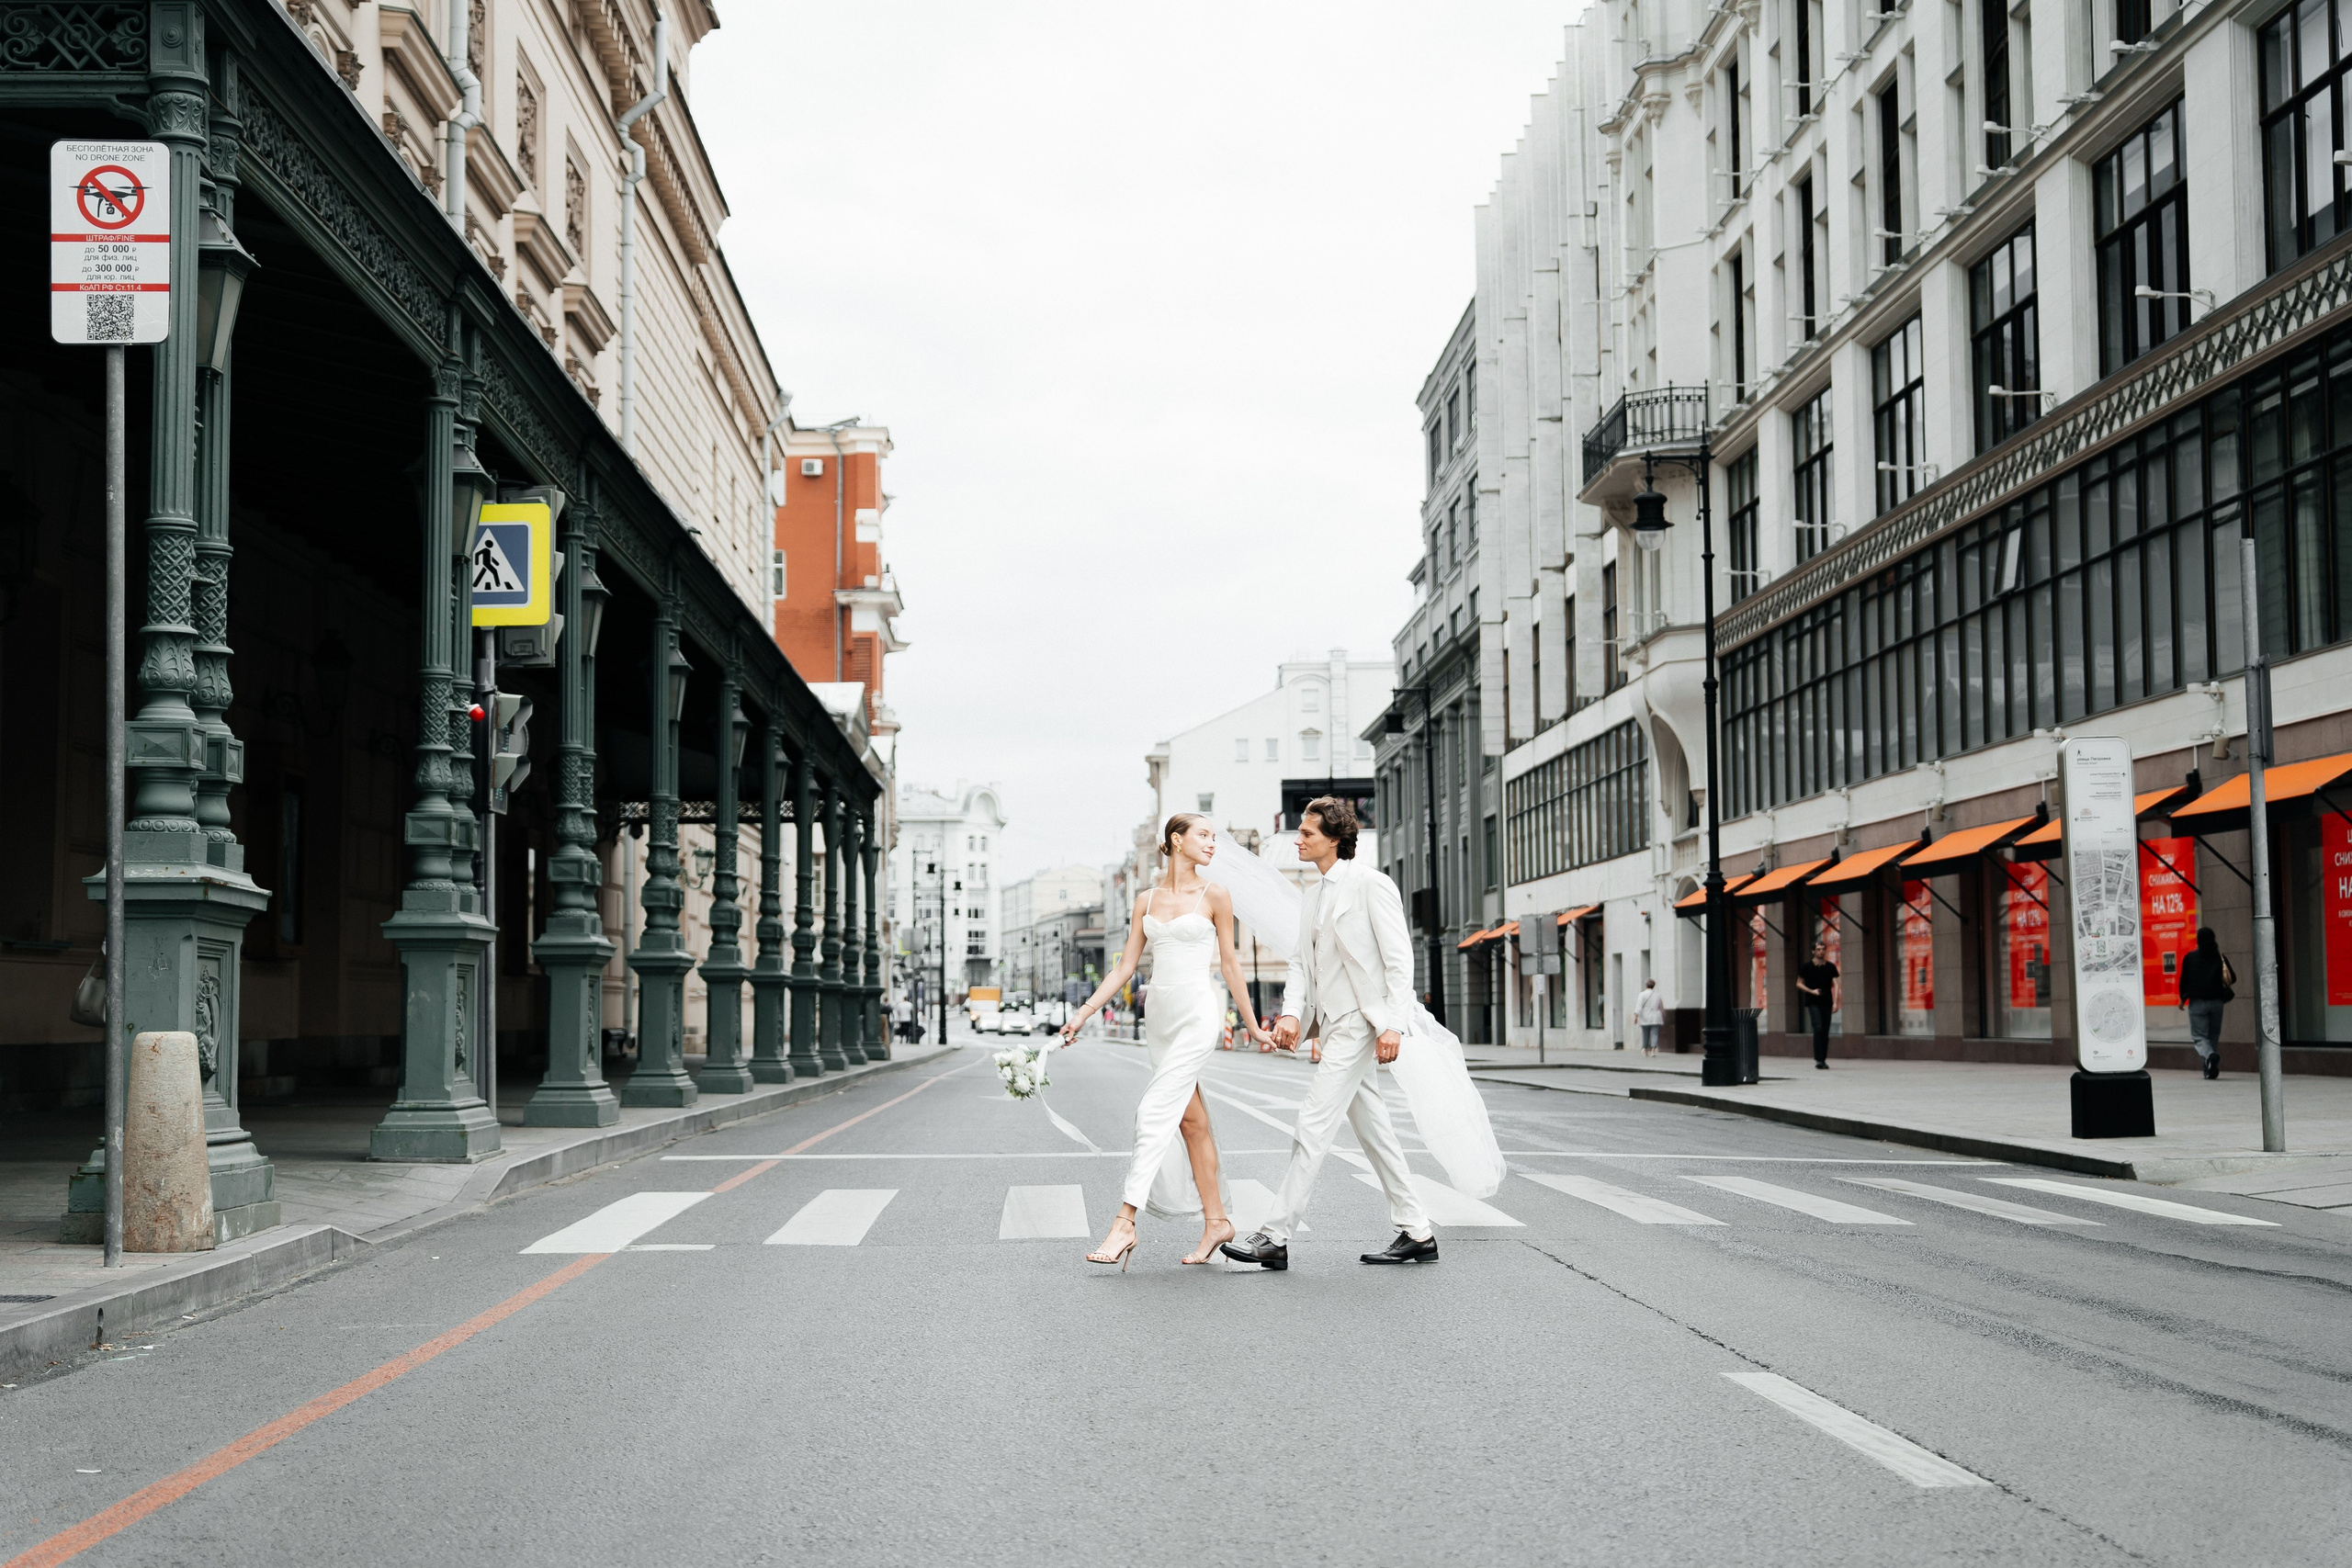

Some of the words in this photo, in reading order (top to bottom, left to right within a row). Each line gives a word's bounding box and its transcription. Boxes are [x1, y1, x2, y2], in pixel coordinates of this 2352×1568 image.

[66, 144, 129, 152] БЕСПОЛЁТНАЯ
[130, 145, 154, 153] ЗОНА
[97, 244, 109, 253] 50
[112, 244, 130, 253] 000
[101, 254, 119, 262] физ.
[95, 264, 112, 272] 300
[115, 264, 132, 272] 000
[2152, 896, 2165, 915] НА
[2165, 893, 2184, 913] 12%
